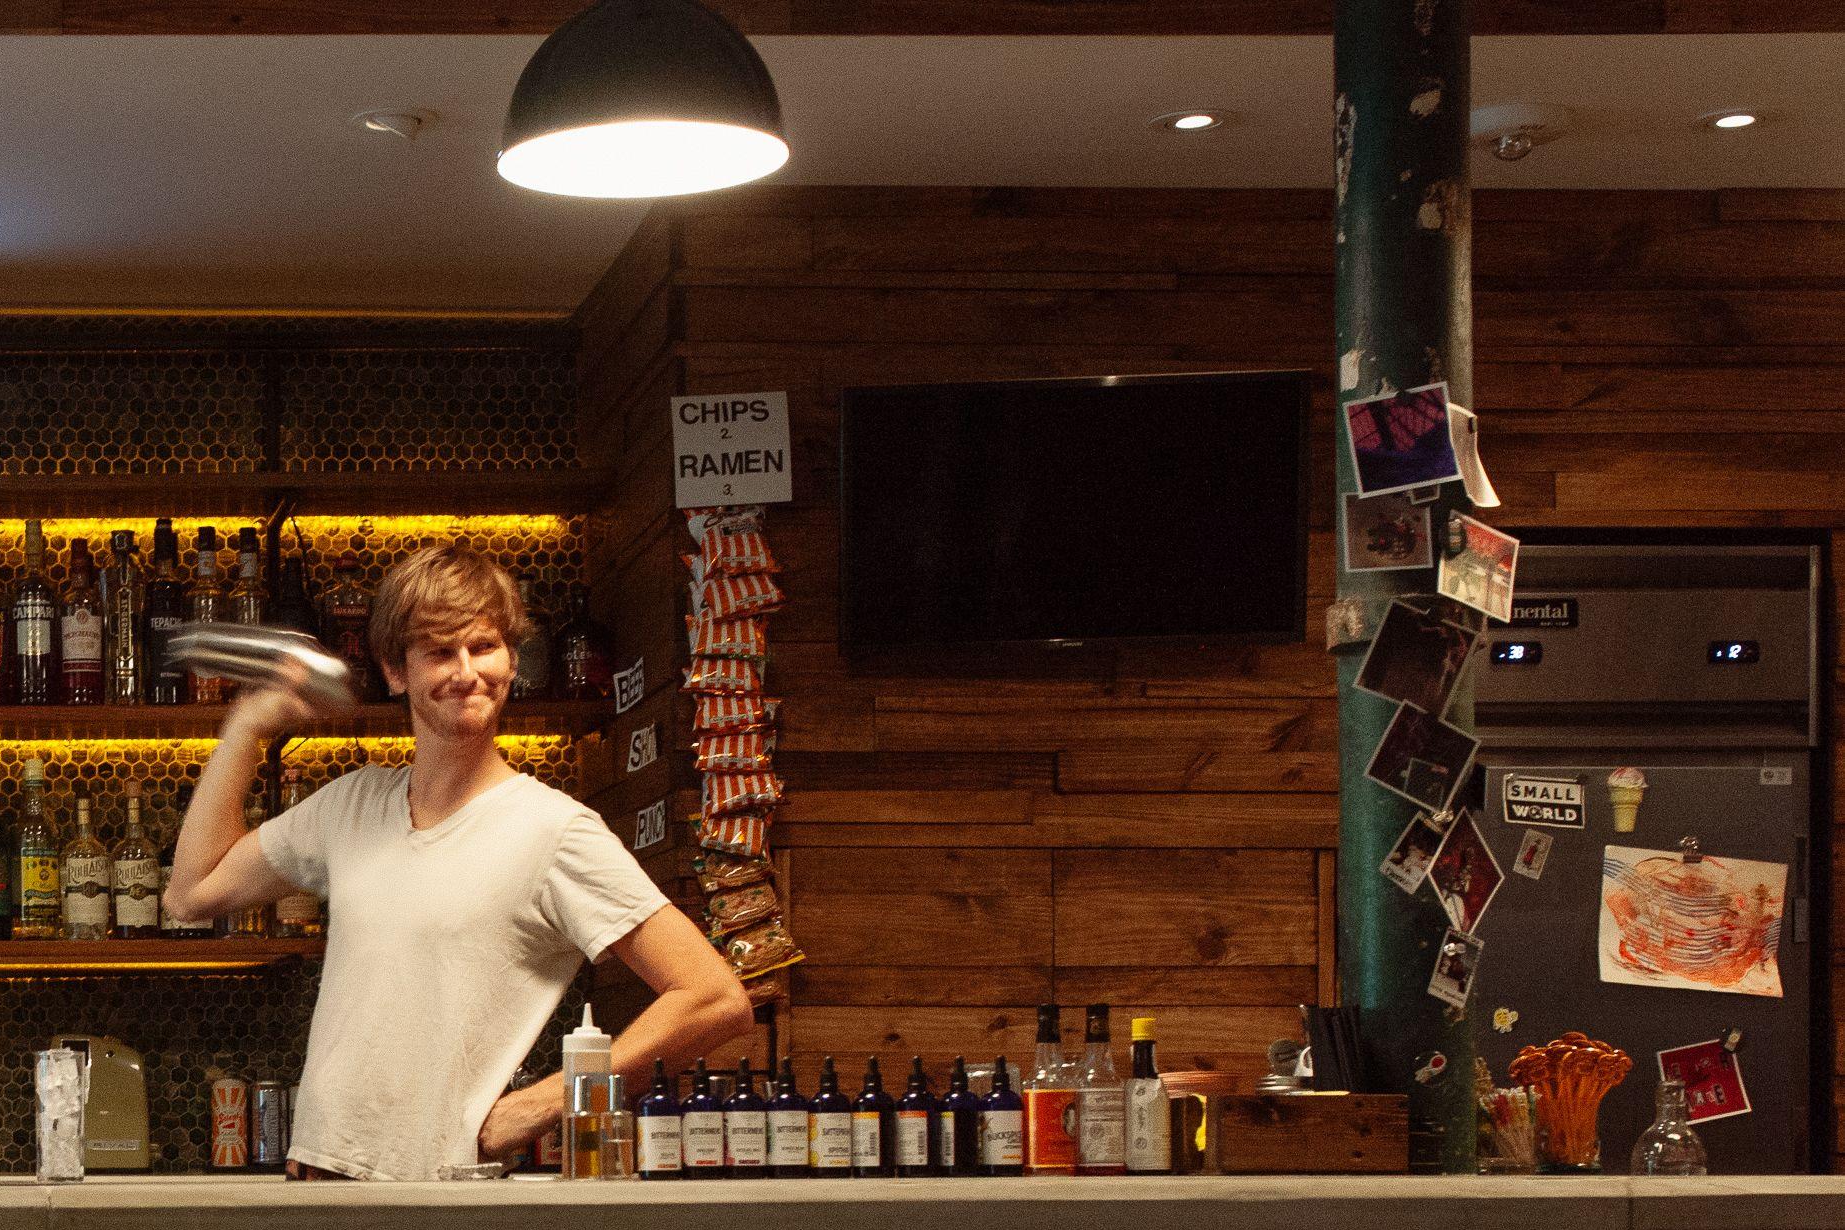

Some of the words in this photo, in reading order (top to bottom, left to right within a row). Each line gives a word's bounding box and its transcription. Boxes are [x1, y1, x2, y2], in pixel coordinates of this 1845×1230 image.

[678, 400, 770, 425] CHIPS
[679, 450, 784, 479] RAMEN
[1511, 784, 1575, 801] SMALL
[1511, 804, 1577, 822] WORLD
